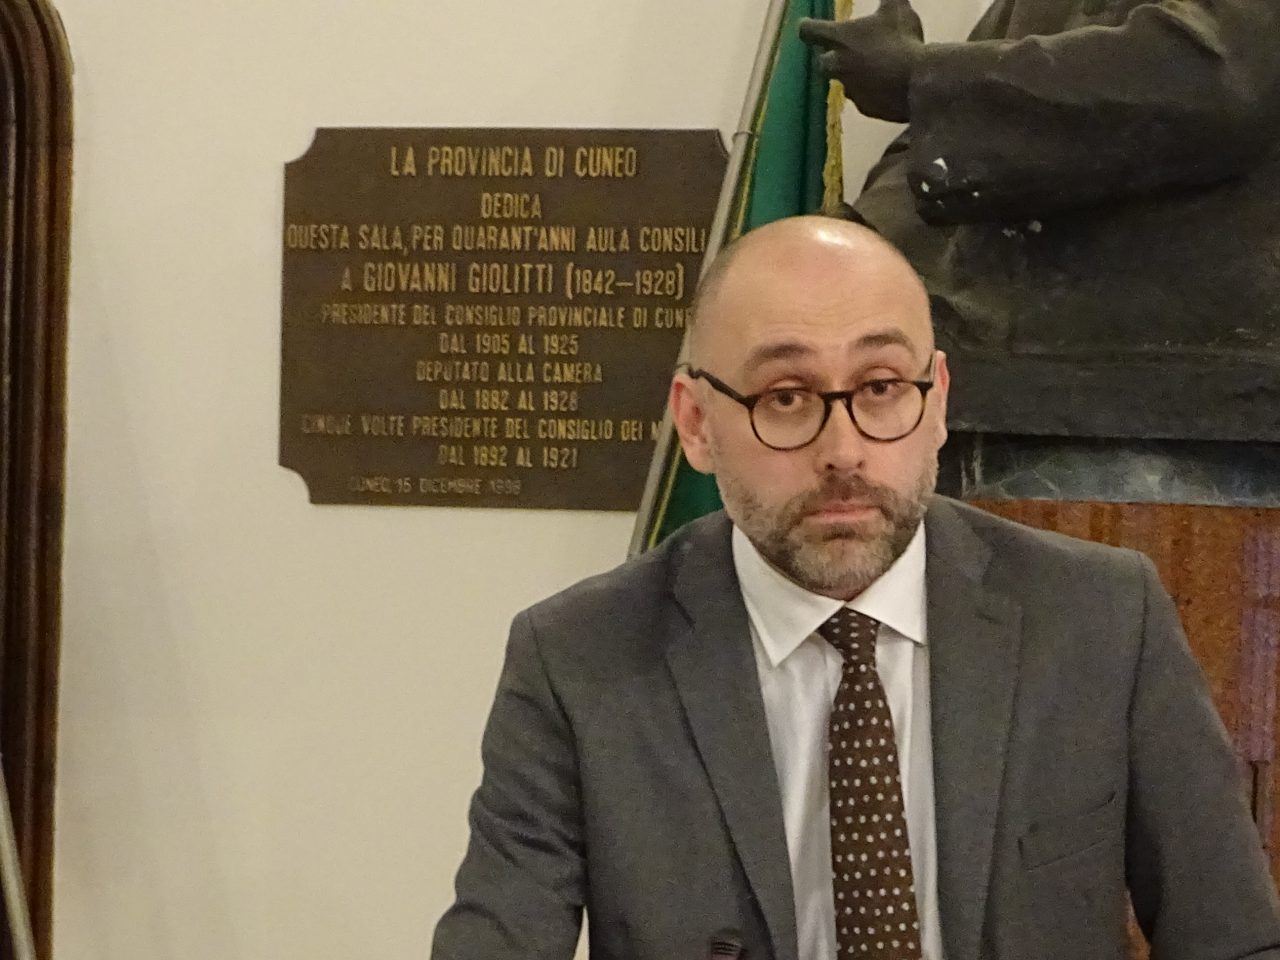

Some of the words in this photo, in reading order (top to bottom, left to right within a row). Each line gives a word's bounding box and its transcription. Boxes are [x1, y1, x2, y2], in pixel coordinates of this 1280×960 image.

[390, 146, 416, 176] LA
[428, 146, 534, 177] PROVINCIA
[545, 147, 564, 177] DI
[575, 147, 637, 177] CUNEO
[481, 192, 542, 218] DEDICA
[287, 223, 350, 249] QUESTA
[413, 224, 444, 250] PER
[452, 225, 576, 251] QUARANT'ANNI
[586, 226, 630, 251] AULA
[640, 227, 707, 253] CONSILI
[341, 266, 352, 291] A
[363, 262, 457, 292] GIOVANNI
[468, 262, 553, 294] GIOLITTI
[321, 303, 406, 325] PRESIDENTE
[412, 303, 437, 325] DEL
[444, 304, 521, 326] CONSIGLIO
[528, 306, 625, 328] PROVINCIALE
[633, 307, 647, 328] DI
[439, 332, 467, 353] DAL
[475, 333, 510, 354] 1905
[517, 334, 535, 354] AL
[543, 334, 579, 355] 1925
[416, 361, 489, 382] DEPUTATO
[497, 361, 534, 382] ALLA
[542, 362, 602, 383] CAMERA
[439, 389, 466, 410] DAL
[517, 390, 535, 411] AL
[361, 415, 404, 436] VOLTE
[412, 416, 498, 438] PRESIDENTE
[505, 417, 530, 438] DEL
[537, 418, 613, 440] CONSIGLIO
[621, 420, 643, 441] DEI
[436, 445, 465, 466] DAL
[515, 447, 533, 467] AL
[542, 447, 578, 468] 1921
